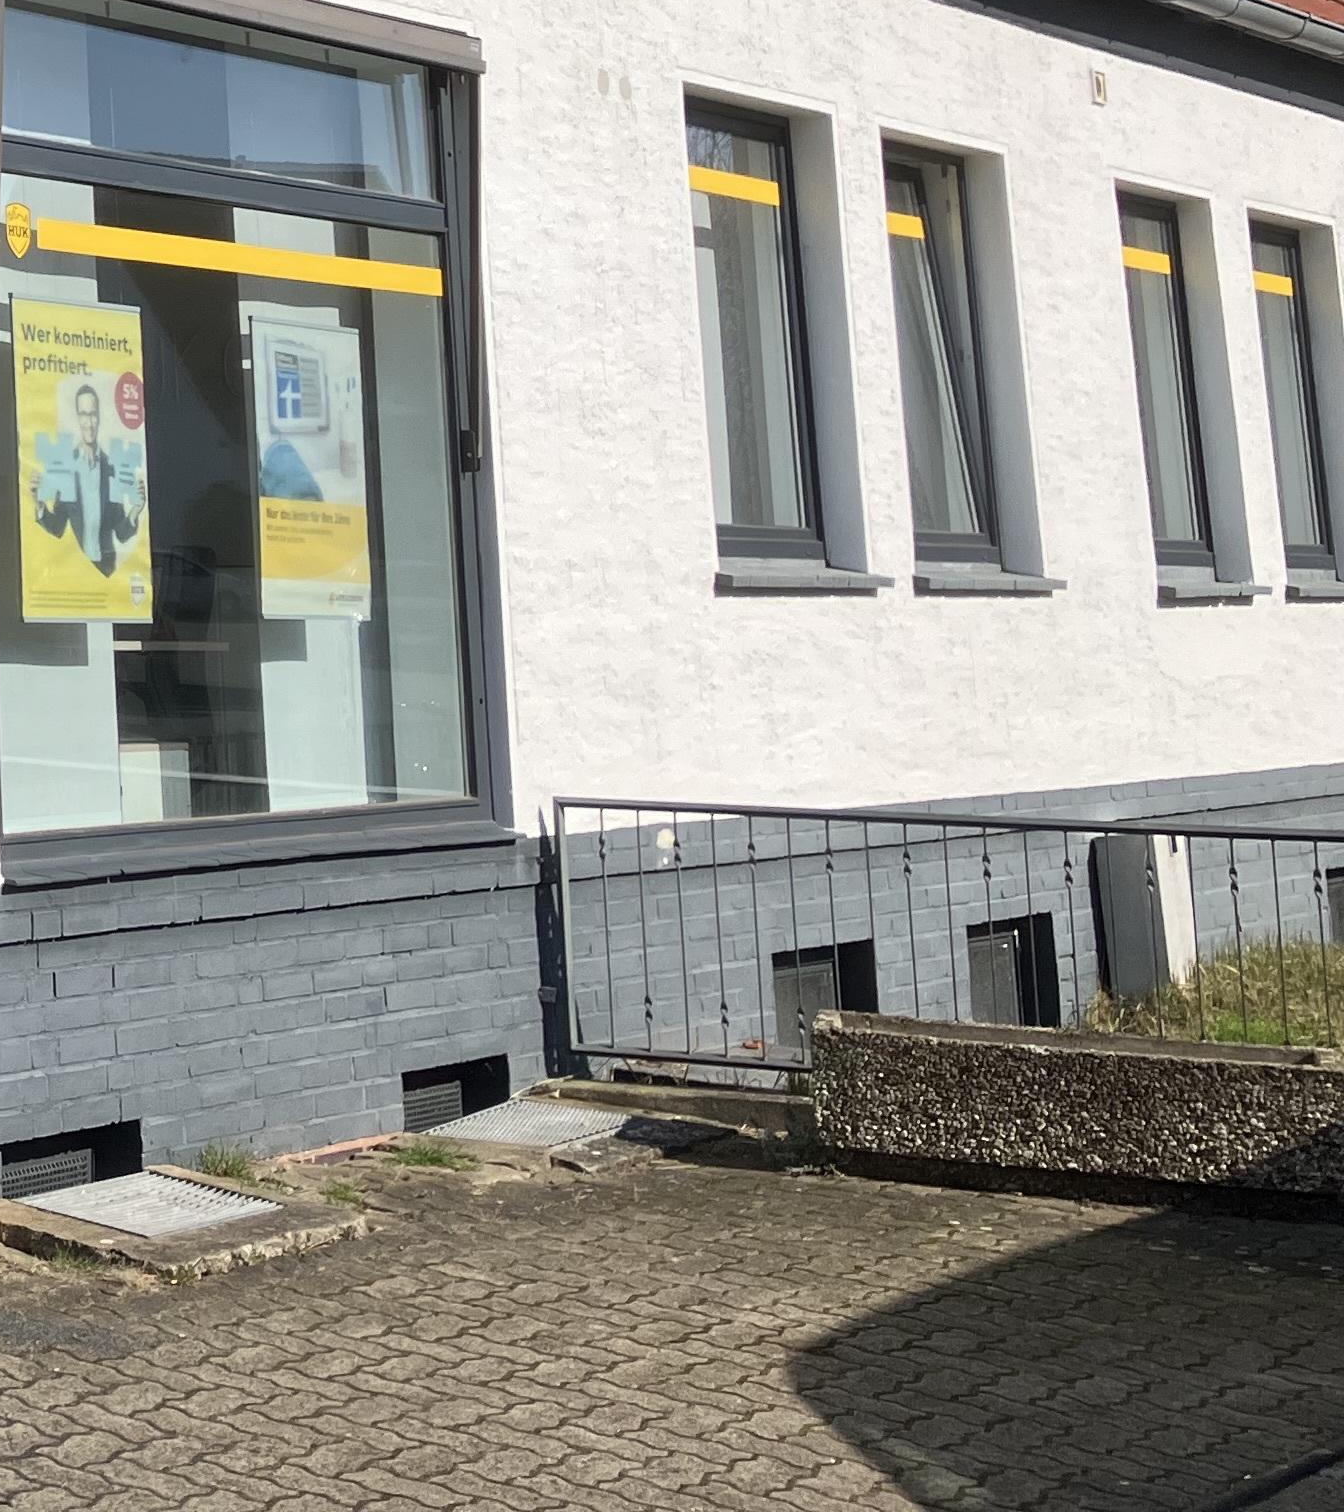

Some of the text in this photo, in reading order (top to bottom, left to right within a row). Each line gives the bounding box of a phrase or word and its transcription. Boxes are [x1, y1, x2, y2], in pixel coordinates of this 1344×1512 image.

[8, 224, 30, 238] HUK
[21, 323, 133, 356] Wer kombiniert,
[23, 353, 93, 377] profitiert.
[122, 383, 140, 400] 5%
